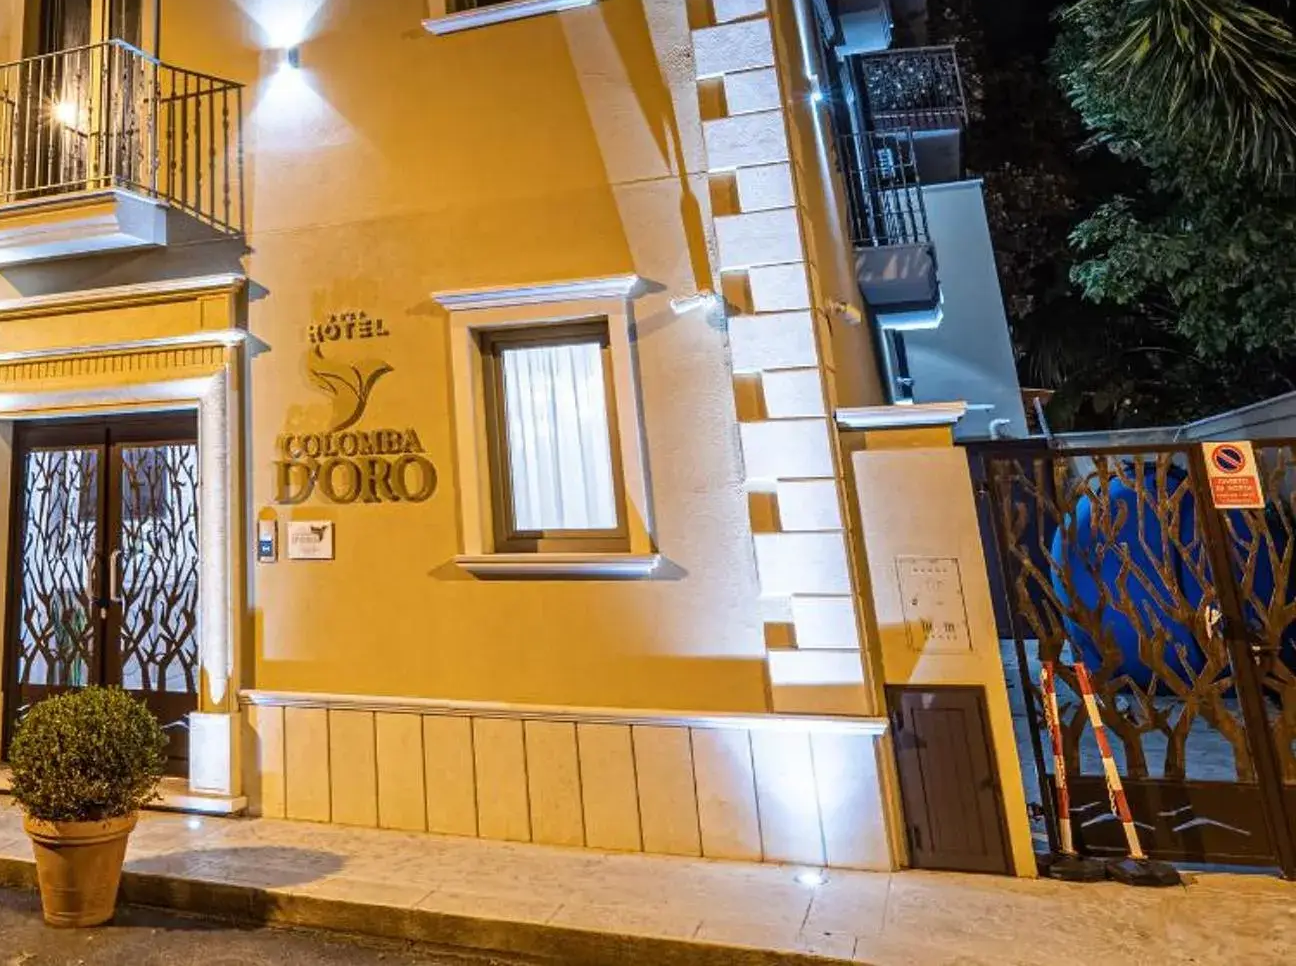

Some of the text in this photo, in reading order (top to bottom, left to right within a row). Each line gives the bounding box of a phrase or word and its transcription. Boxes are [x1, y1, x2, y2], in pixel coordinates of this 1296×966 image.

[309, 318, 390, 343] HOTEL
[278, 428, 426, 458] COLOMBA
[273, 454, 437, 504] D'ORO
